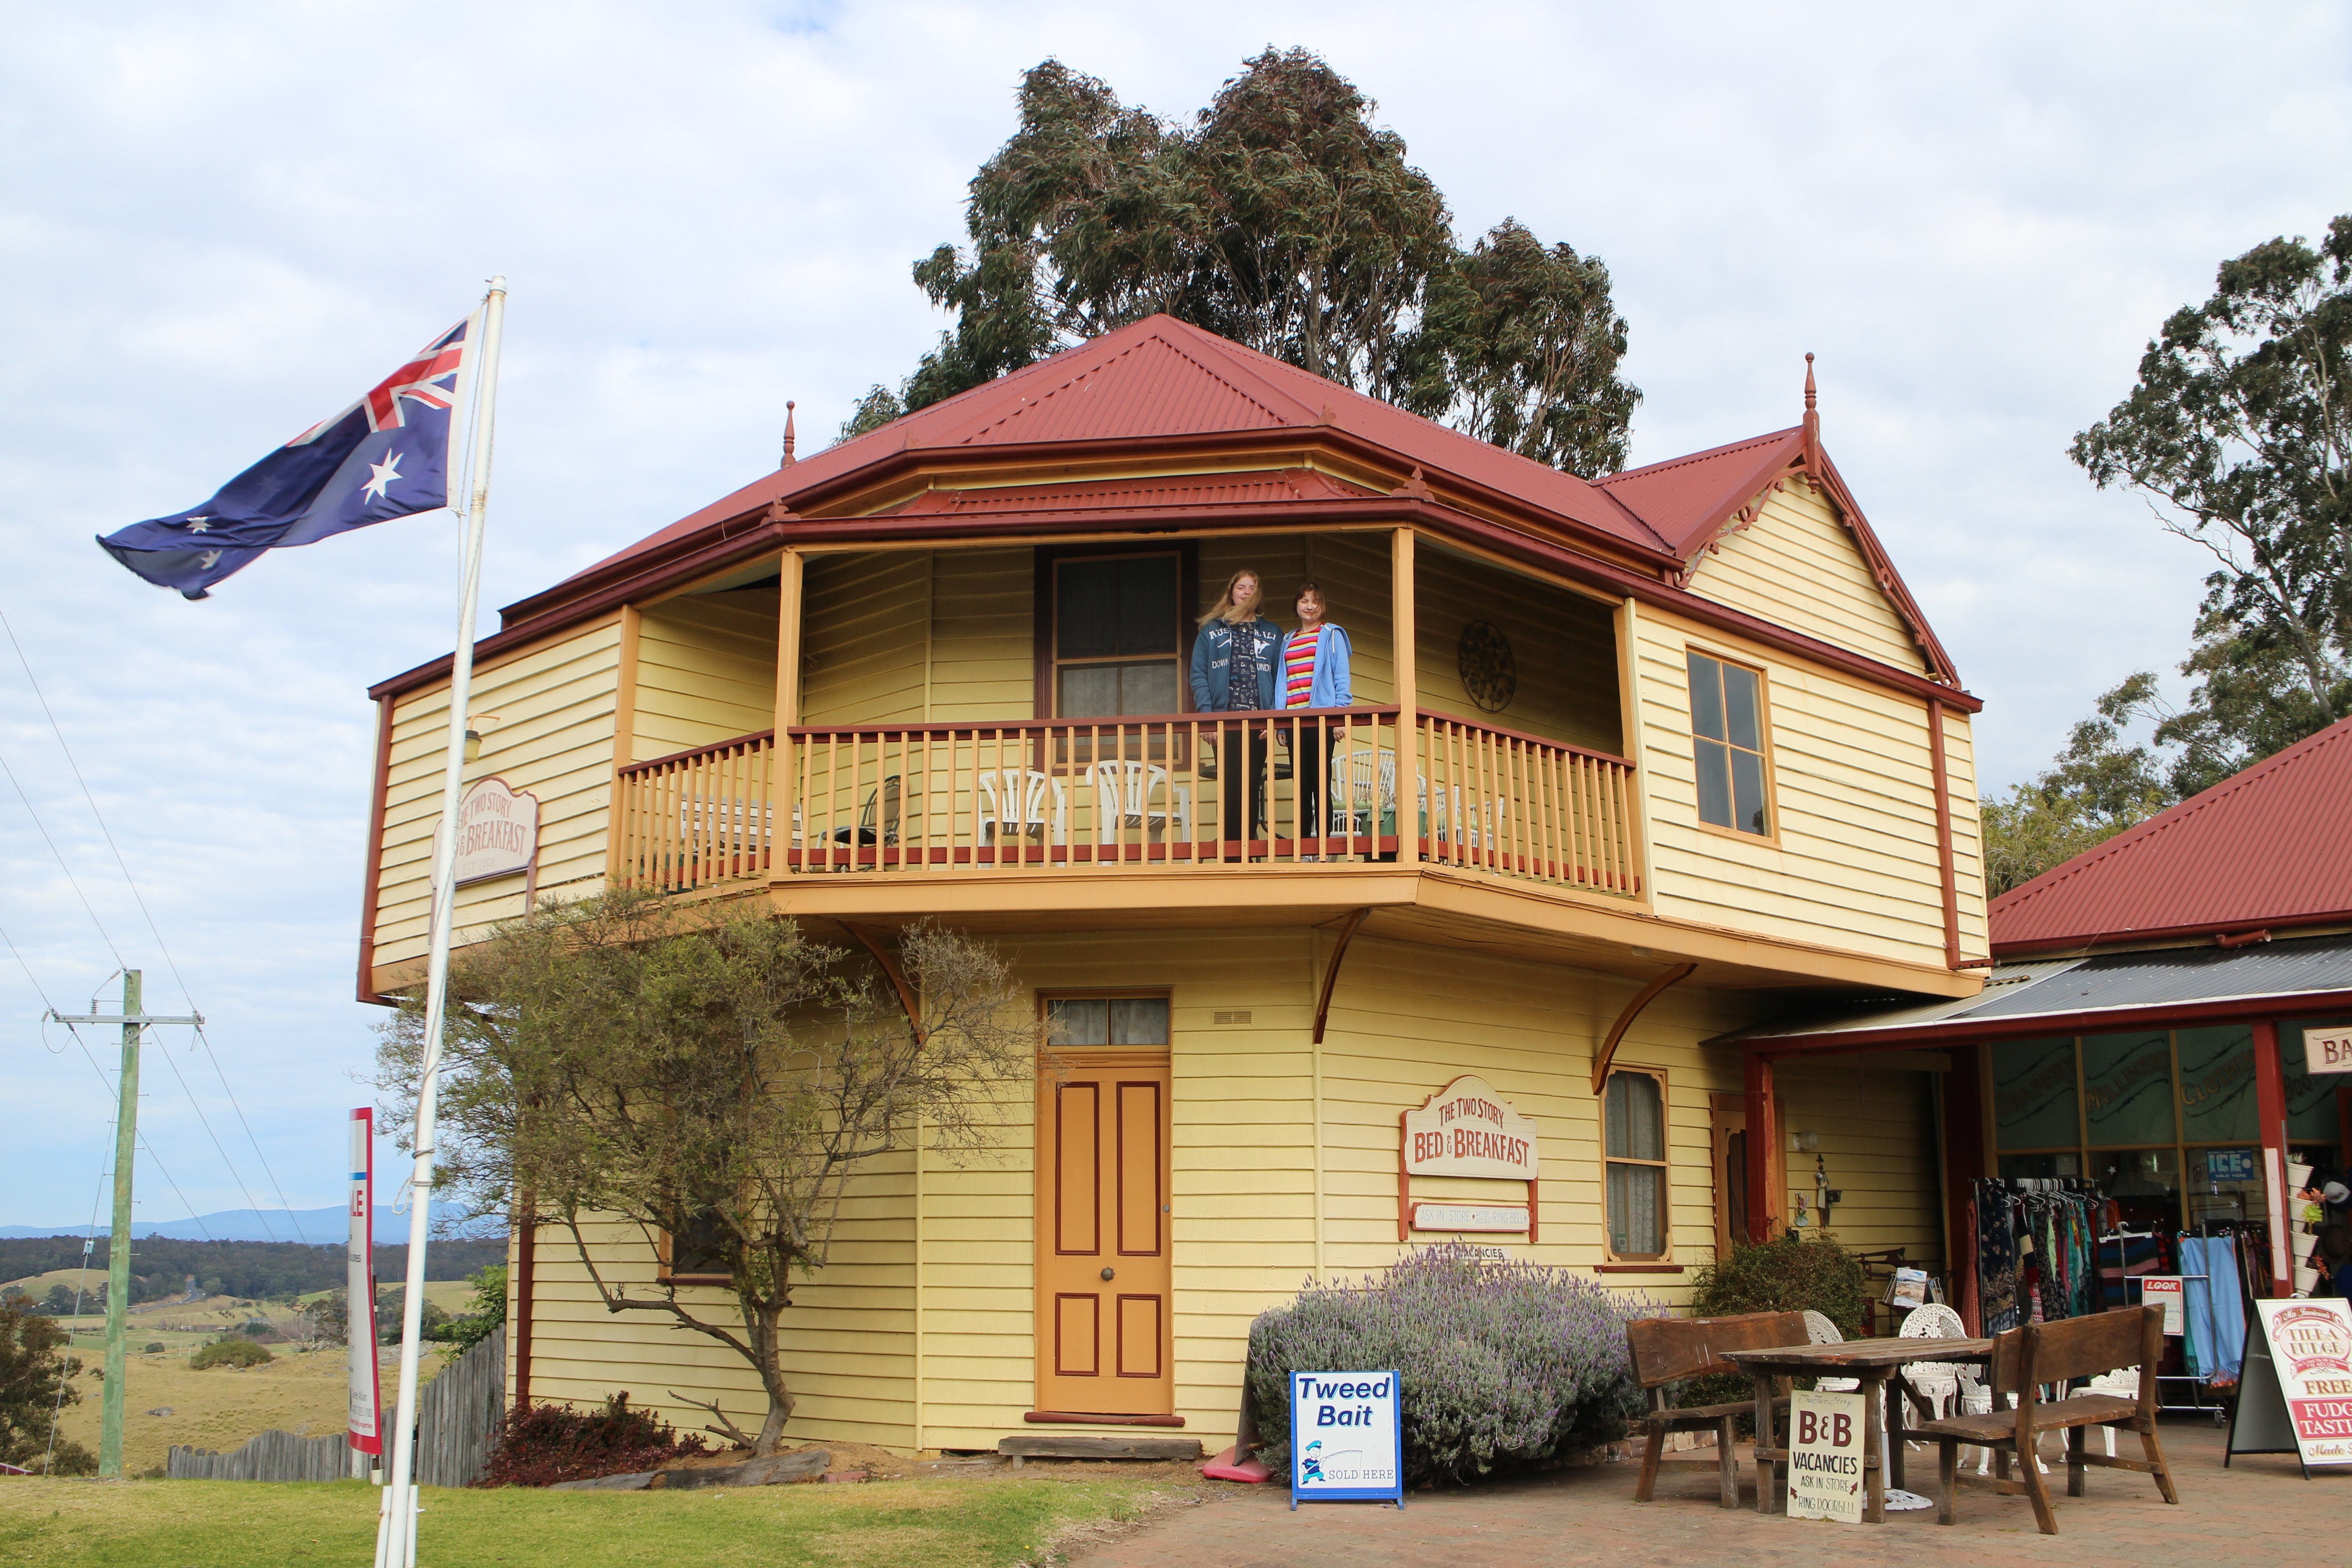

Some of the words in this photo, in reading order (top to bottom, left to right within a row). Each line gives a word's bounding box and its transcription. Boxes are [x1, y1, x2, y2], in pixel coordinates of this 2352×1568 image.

[458, 806, 468, 830] HE
[470, 793, 486, 819] TWO
[487, 792, 513, 818] STORY
[460, 835, 465, 856] &
[466, 820, 526, 857] BREAKFAST
[2085, 1051, 2171, 1114] MILLINERY
[2180, 1049, 2256, 1106] CLOTHIN
[1996, 1055, 2076, 1117] DRAPERY
[1439, 1100, 1455, 1127] THE
[1456, 1098, 1476, 1118] TWO
[1478, 1098, 1504, 1129] STORY
[1414, 1131, 1443, 1164] BED
[1447, 1135, 1452, 1154] &
[1454, 1129, 1529, 1168] BREAKFAST
[2208, 1154, 2241, 1173] ICE
[1421, 1210, 1434, 1221] ASK
[1436, 1210, 1445, 1221] IN
[1449, 1210, 1470, 1222] STORE
[1493, 1212, 1509, 1224] RING
[1510, 1212, 1524, 1224] BELL
[2147, 1281, 2177, 1290] LOOK
[2298, 1307, 2330, 1319] Jamieson's
[2285, 1328, 2341, 1341] TILBA
[2289, 1342, 2345, 1356] FUDGE
[1298, 1377, 1390, 1399] Tweed
[2303, 1380, 2352, 1395] FREE
[1798, 1394, 1813, 1404] The
[1813, 1395, 1828, 1404] Two
[1828, 1396, 1852, 1410] Story
[2303, 1402, 2352, 1417] FUDG
[1317, 1405, 1372, 1427] Bait
[1799, 1410, 1852, 1447] B&B
[2308, 1444, 2345, 1456] Made
[1793, 1451, 1857, 1475] VACANCIES
[1328, 1470, 1358, 1480] SOLD
[1362, 1470, 1394, 1479] HERE
[1801, 1476, 1814, 1488] ASK
[1816, 1476, 1823, 1489] IN
[1826, 1478, 1850, 1492] STORE
[1798, 1496, 1816, 1510] RING
